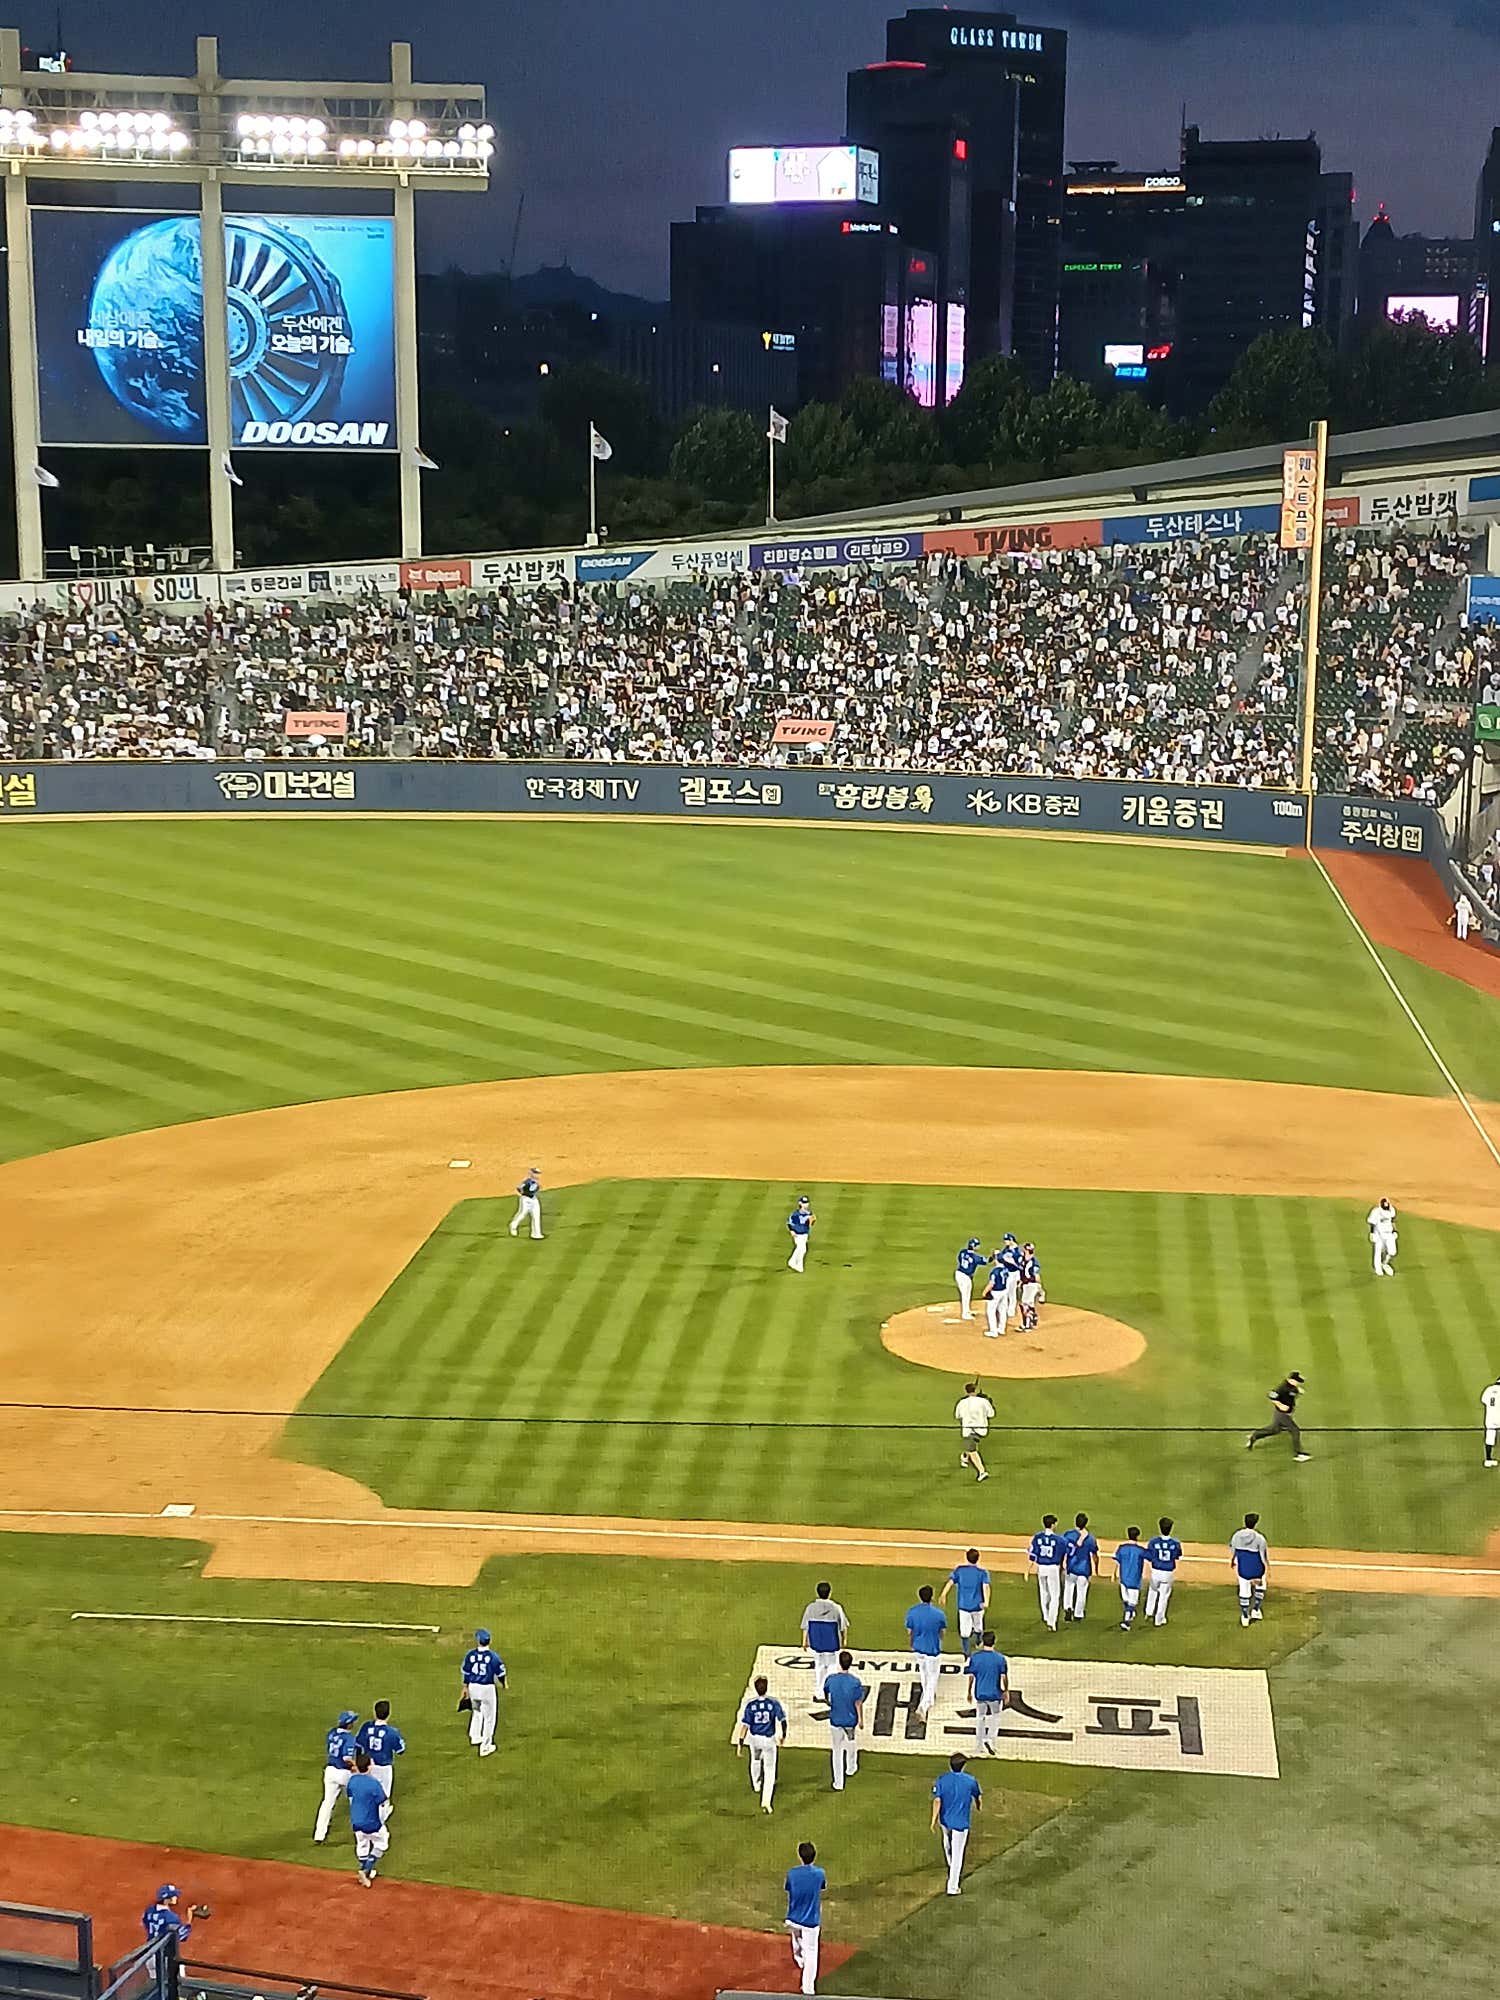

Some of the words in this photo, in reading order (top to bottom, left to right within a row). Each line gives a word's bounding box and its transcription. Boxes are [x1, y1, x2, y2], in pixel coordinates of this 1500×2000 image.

[282, 314, 344, 334] 두산에겐
[77, 328, 125, 348] 내일의
[271, 334, 318, 353] 오늘의
[240, 420, 389, 445] DOOSAN
[1371, 489, 1458, 521] 두산밥캣
[1146, 510, 1243, 537] 두산테스나
[974, 527, 1052, 551] TVING
[482, 559, 566, 584] 두산밥캣
[580, 556, 632, 569] DOOSAN
[671, 550, 744, 570] 두산퓨얼셀
[154, 574, 203, 602] SOUL
[781, 726, 827, 736] TVING
[0, 772, 36, 807] 설
[525, 777, 640, 800] 한국경제TV
[1122, 795, 1225, 830] 키움증권
[1272, 800, 1304, 818] 100m
[471, 1662, 487, 1676] 45
